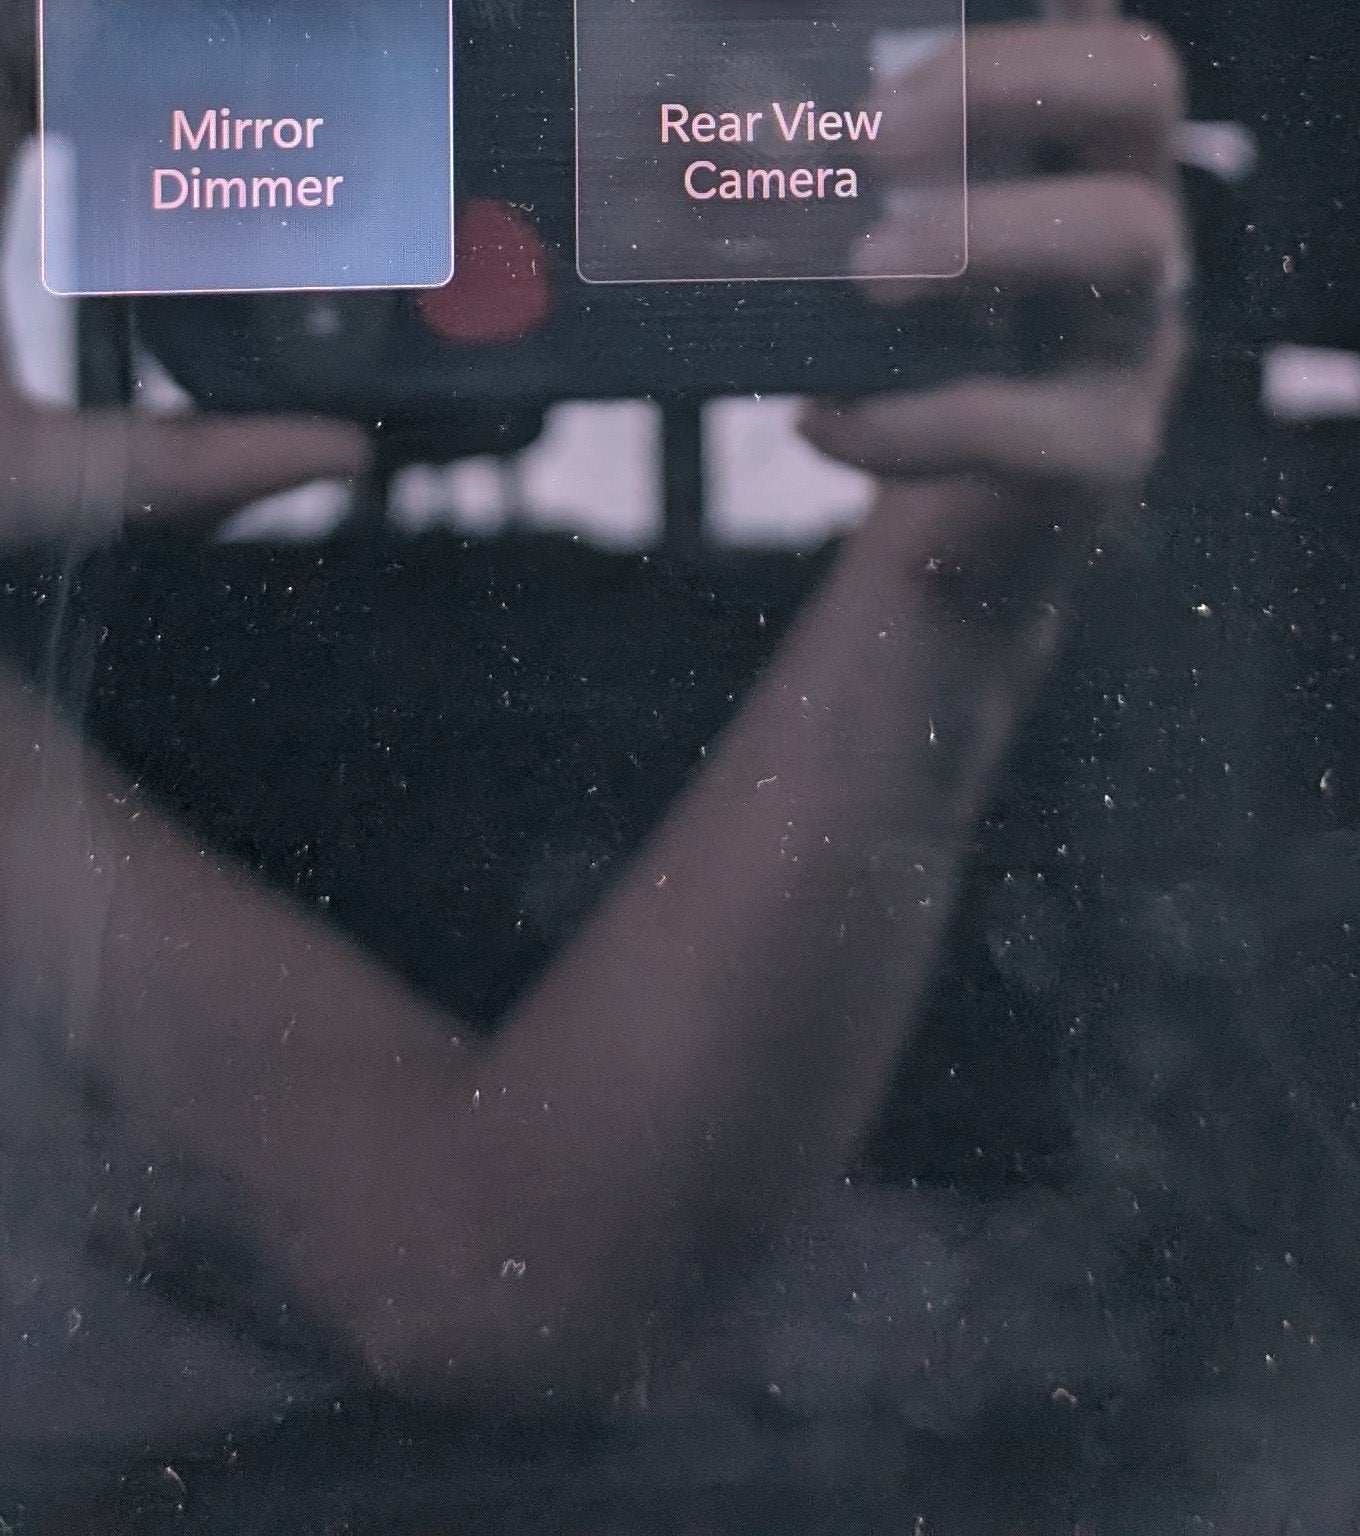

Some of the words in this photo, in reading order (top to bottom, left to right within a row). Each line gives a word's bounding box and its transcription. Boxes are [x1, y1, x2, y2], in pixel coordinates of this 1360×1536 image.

[171, 109, 324, 152] Mirror
[659, 104, 763, 144] Rear
[774, 102, 884, 143] View
[151, 169, 344, 210] Dimmer
[683, 161, 858, 201] Camera
